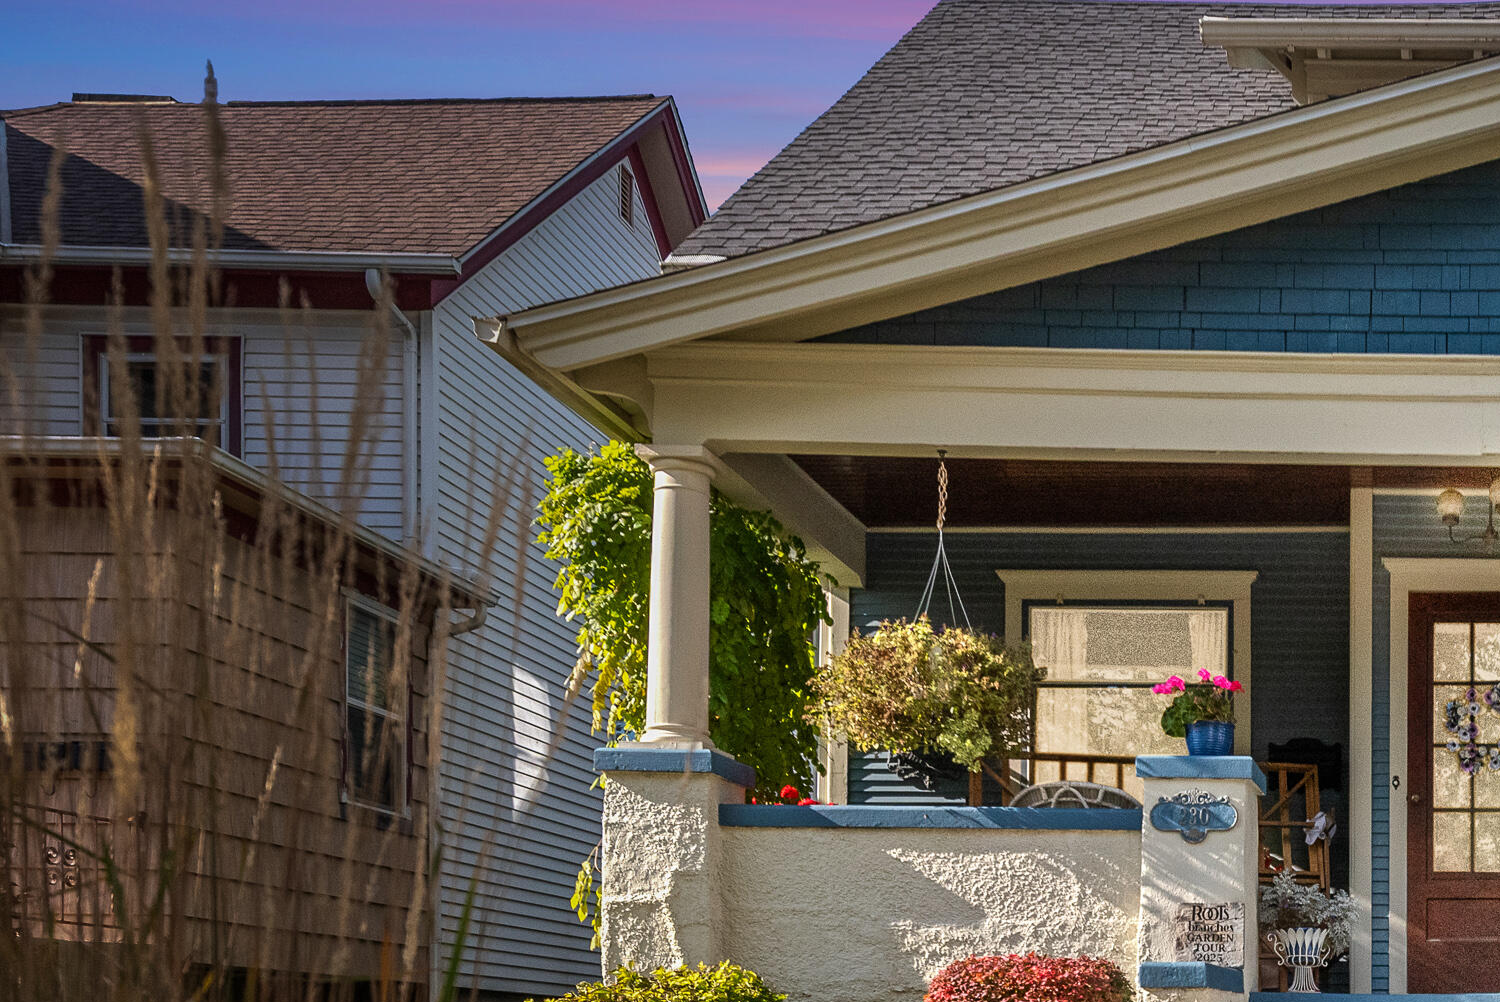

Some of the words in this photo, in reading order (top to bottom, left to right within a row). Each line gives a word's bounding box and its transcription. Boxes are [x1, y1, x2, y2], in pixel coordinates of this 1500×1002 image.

[1188, 920, 1234, 931] branches
[1186, 933, 1234, 942] GARDEN
[1193, 943, 1226, 952] TOUR
[1196, 953, 1223, 962] 2025
